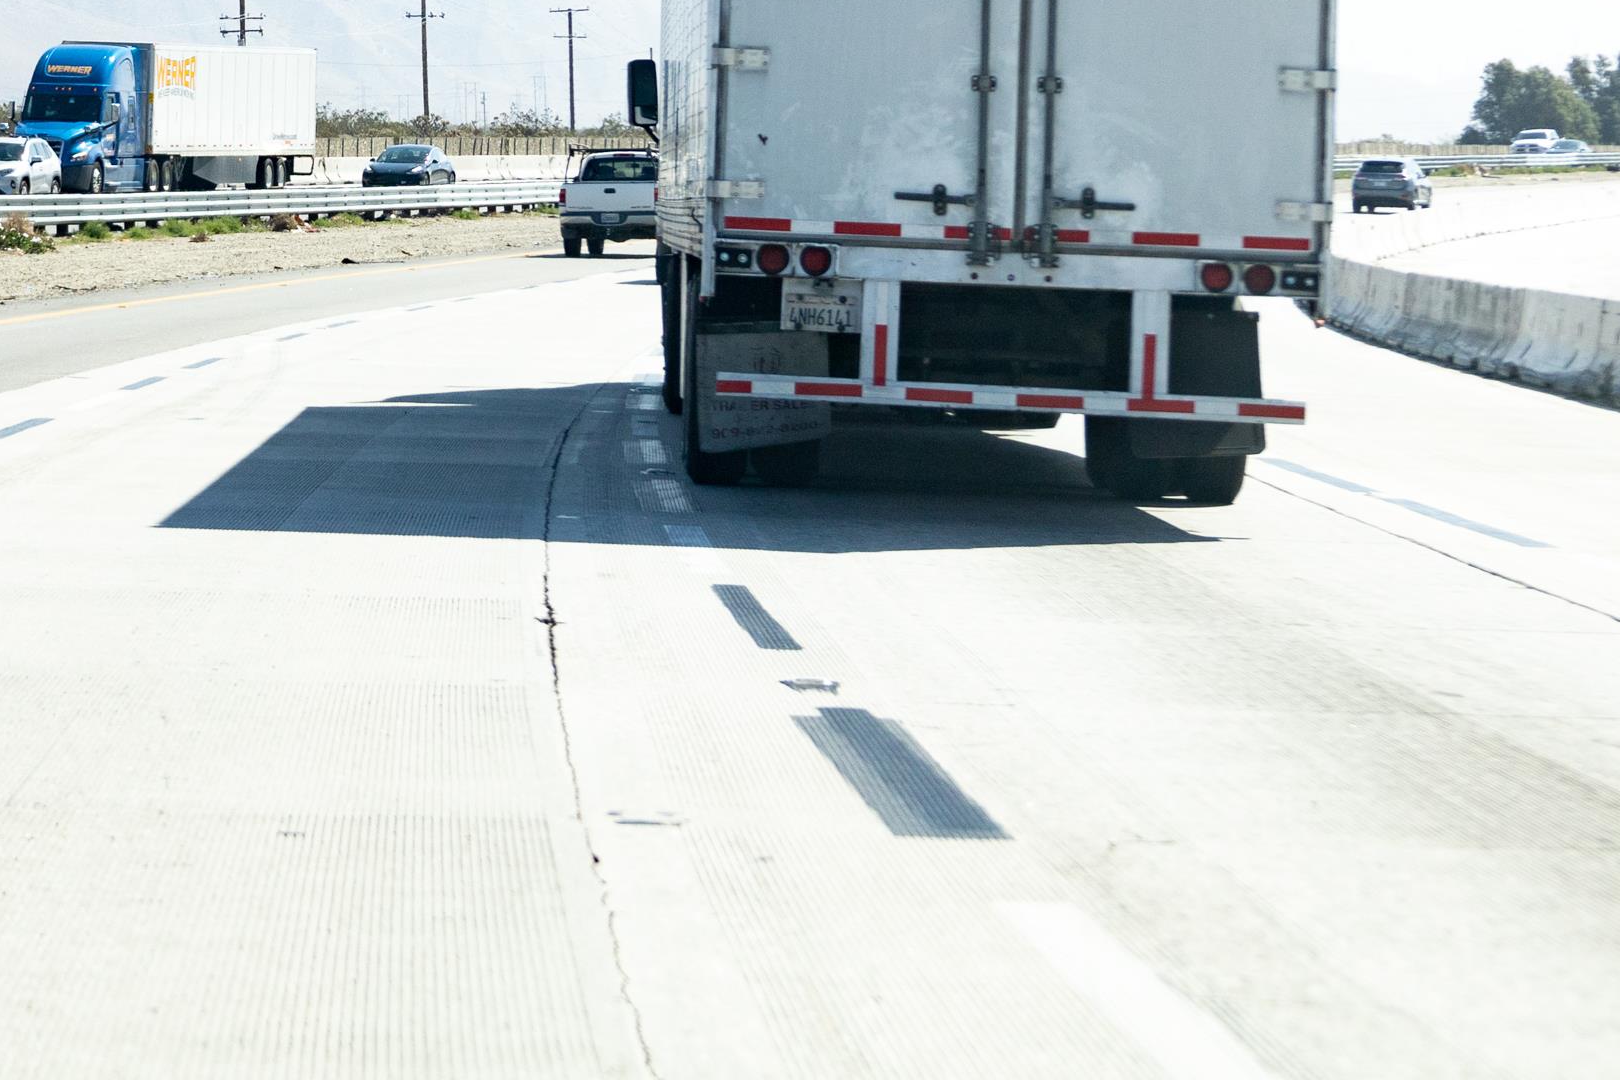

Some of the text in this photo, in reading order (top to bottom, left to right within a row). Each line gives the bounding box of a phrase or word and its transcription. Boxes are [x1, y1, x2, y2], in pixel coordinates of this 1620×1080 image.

[47, 65, 92, 74] WERNER
[156, 56, 196, 90] WERNER
[789, 307, 853, 328] 4NH6141
[711, 400, 769, 411] TRAER
